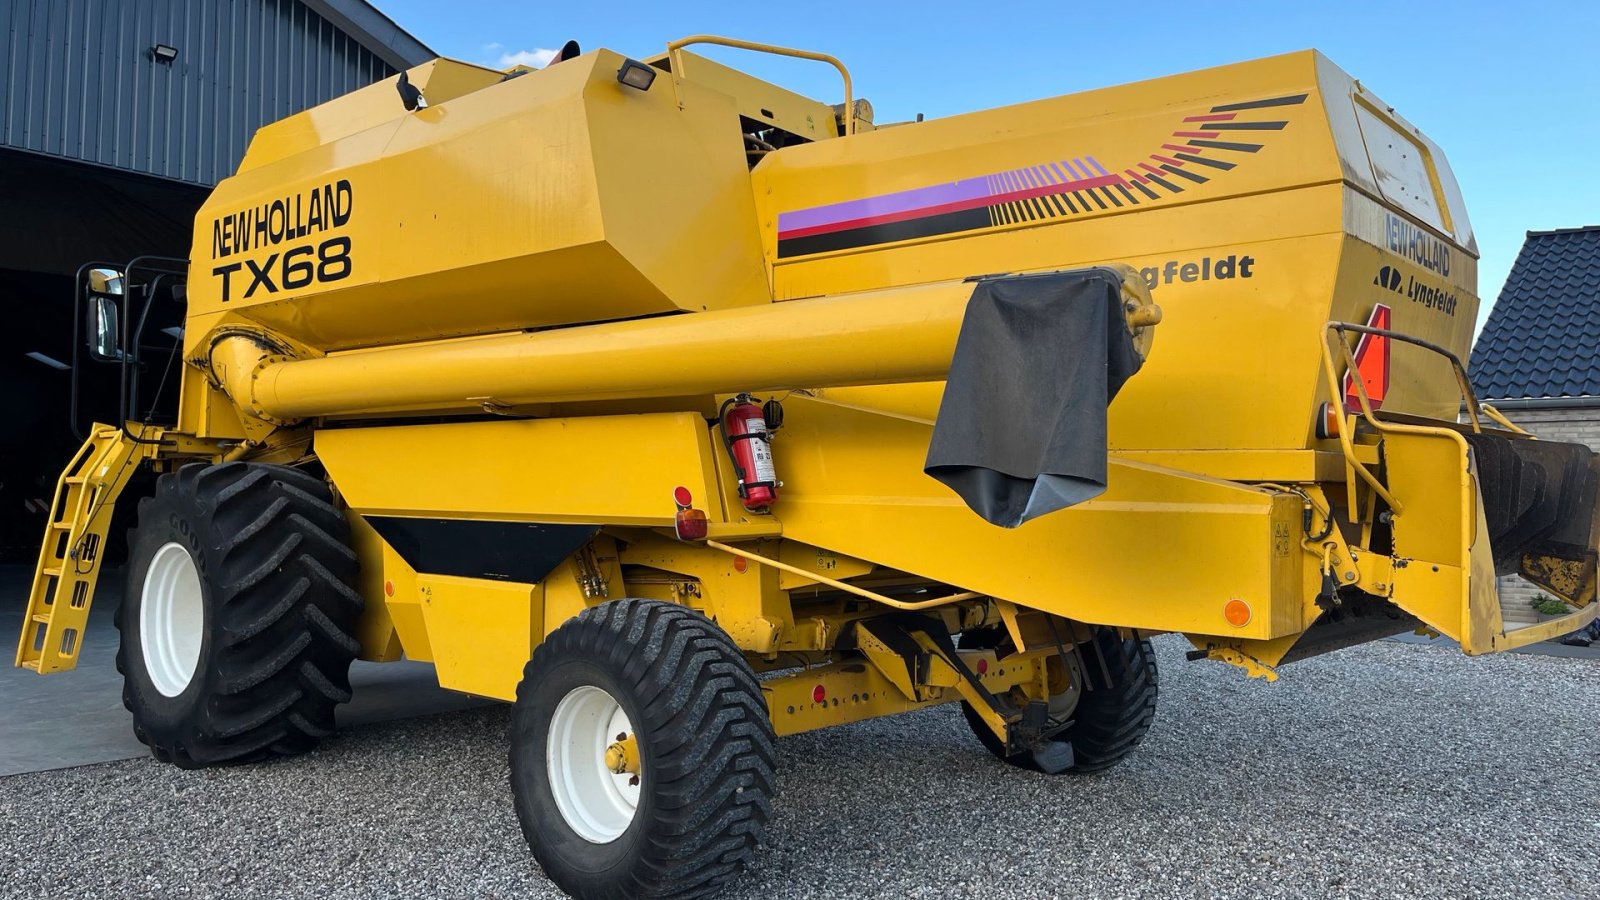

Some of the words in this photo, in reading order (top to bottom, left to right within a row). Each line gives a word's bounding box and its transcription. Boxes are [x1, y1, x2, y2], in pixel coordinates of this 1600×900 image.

[213, 209, 252, 260] NEW
[255, 179, 353, 249] HOLLAND
[1386, 213, 1408, 256] NEW
[1409, 225, 1449, 277] HOLLAND
[212, 236, 352, 302] TX68
[1140, 255, 1255, 290] gfeldt
[1407, 275, 1457, 316] Lyngfeldt
